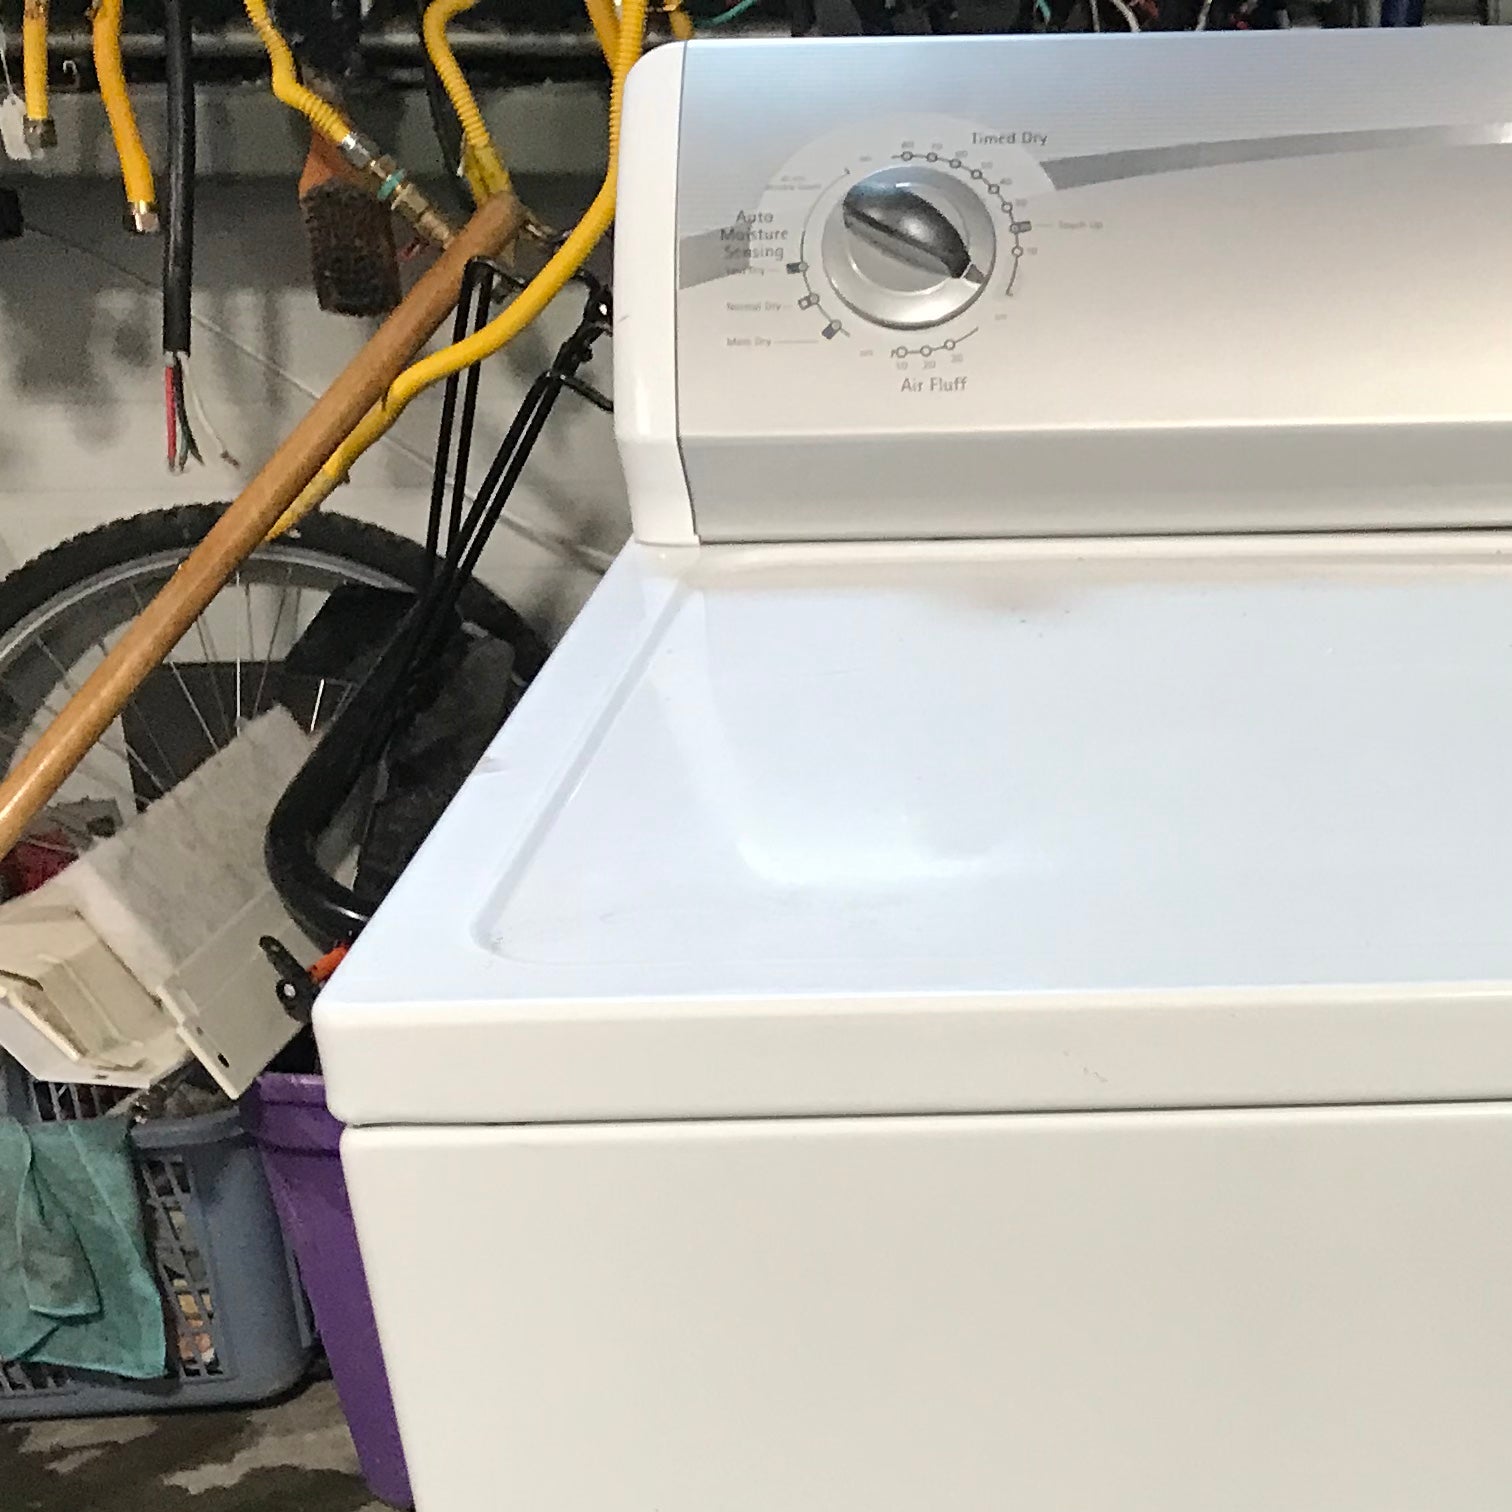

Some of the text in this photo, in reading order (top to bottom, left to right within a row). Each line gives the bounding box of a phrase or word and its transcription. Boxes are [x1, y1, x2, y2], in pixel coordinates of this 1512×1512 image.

[972, 131, 1048, 146] Timed Dry
[736, 209, 773, 224] Auto
[720, 227, 788, 242] Moisture
[724, 244, 785, 261] Sensing
[900, 376, 968, 392] Air Fluff
